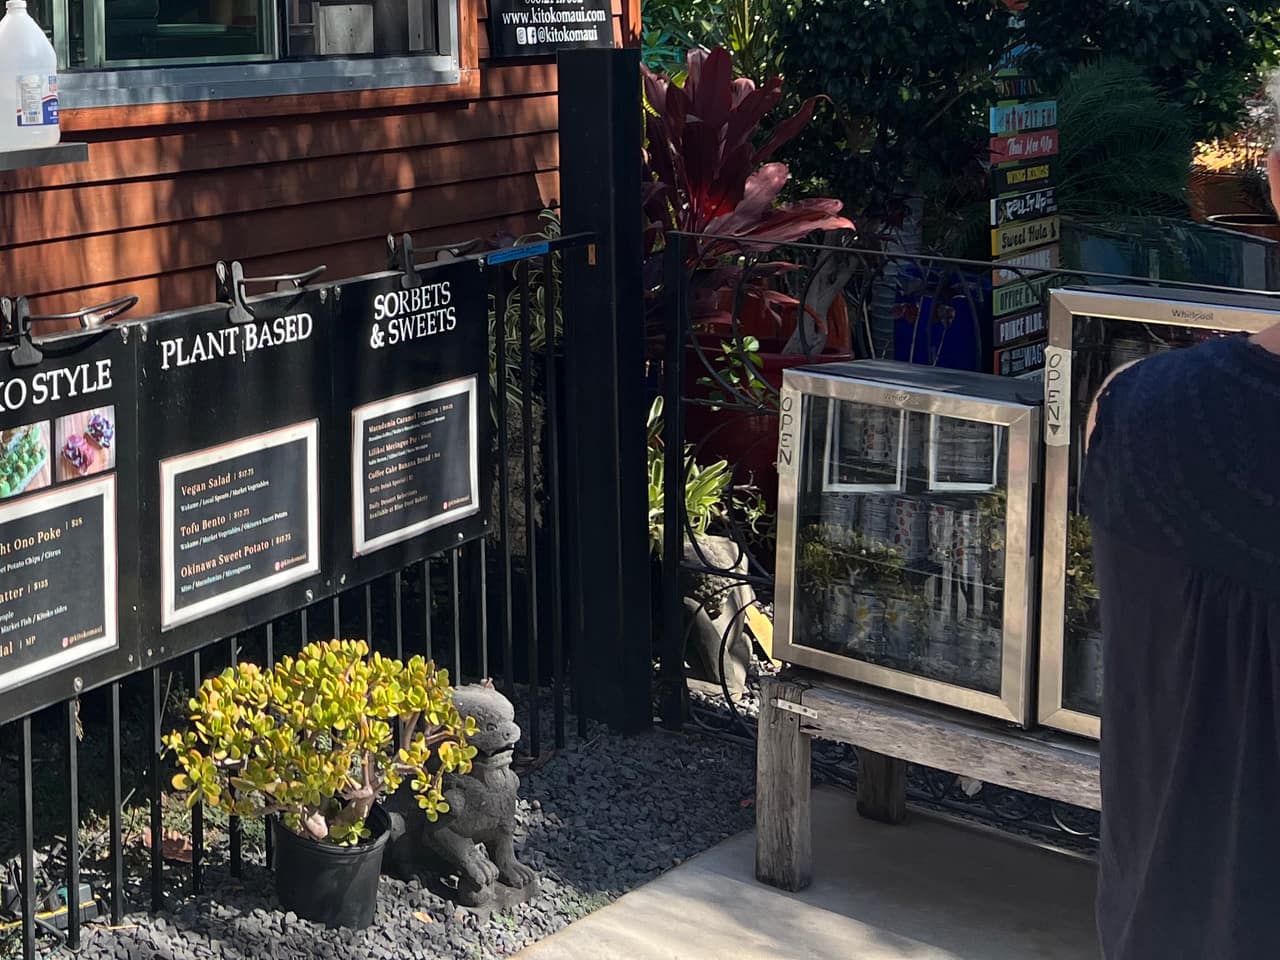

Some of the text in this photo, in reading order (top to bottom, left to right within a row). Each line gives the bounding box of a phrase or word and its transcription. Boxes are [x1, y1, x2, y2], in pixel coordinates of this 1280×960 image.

[502, 8, 606, 23] www.kitokomaui.com
[538, 26, 598, 43] @kitokomaui
[1002, 228, 1026, 248] Sweet
[374, 281, 450, 320] SORBETS
[160, 313, 312, 370] PLANT BASED
[370, 307, 456, 349] & SWEETS
[32, 359, 112, 404] STYLE
[1048, 353, 1062, 422] OPEN
[780, 396, 793, 466] OPEN
[181, 482, 206, 496] Vegan
[208, 472, 231, 489] Salad
[14, 537, 35, 551] Ono
[37, 527, 61, 543] Poke
[180, 522, 200, 537] Tofu
[202, 515, 226, 530] Bento
[181, 559, 217, 578] Okinawa
[218, 550, 242, 565] Sweet
[244, 541, 269, 556] Potato
